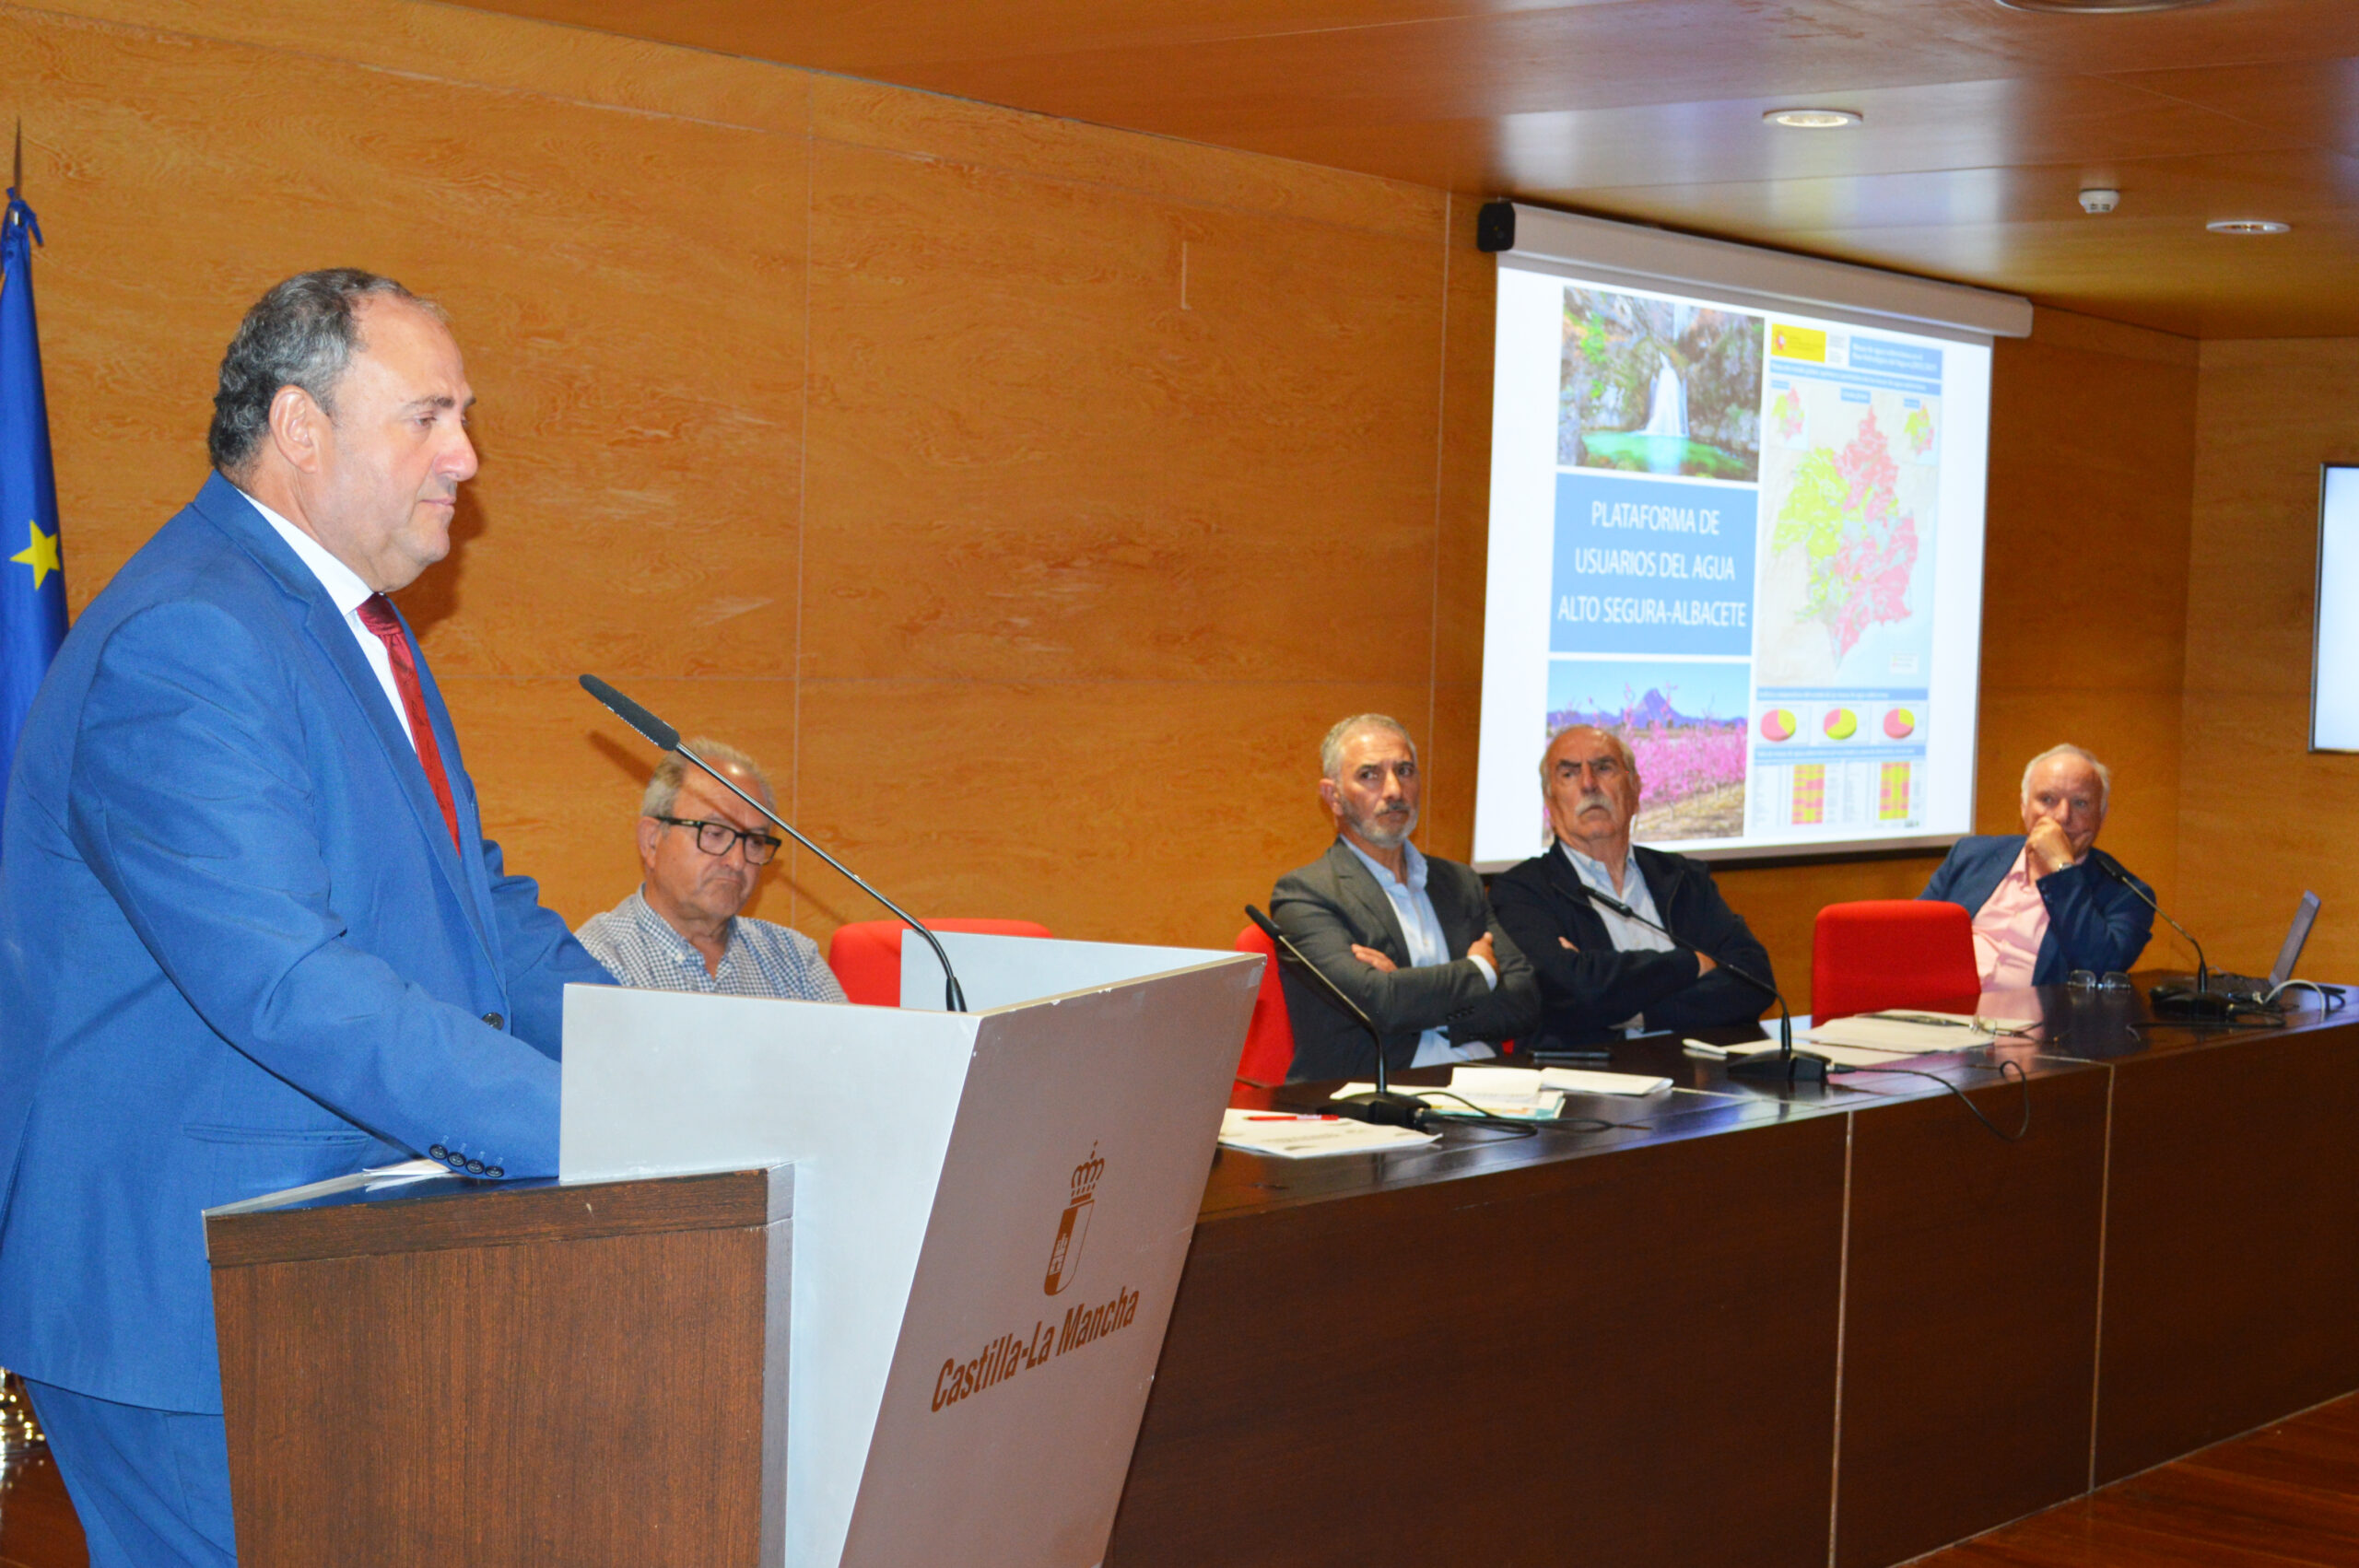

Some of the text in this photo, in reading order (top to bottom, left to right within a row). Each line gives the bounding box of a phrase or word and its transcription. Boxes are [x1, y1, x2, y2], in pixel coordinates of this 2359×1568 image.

[1592, 500, 1720, 535] PLATAFORMA DE
[1575, 547, 1735, 580] USUARIOS DEL AGUA
[1557, 595, 1746, 626] ALTO SEGURA-ALBACETE
[931, 1285, 1140, 1412] Castilla-La Mancha
